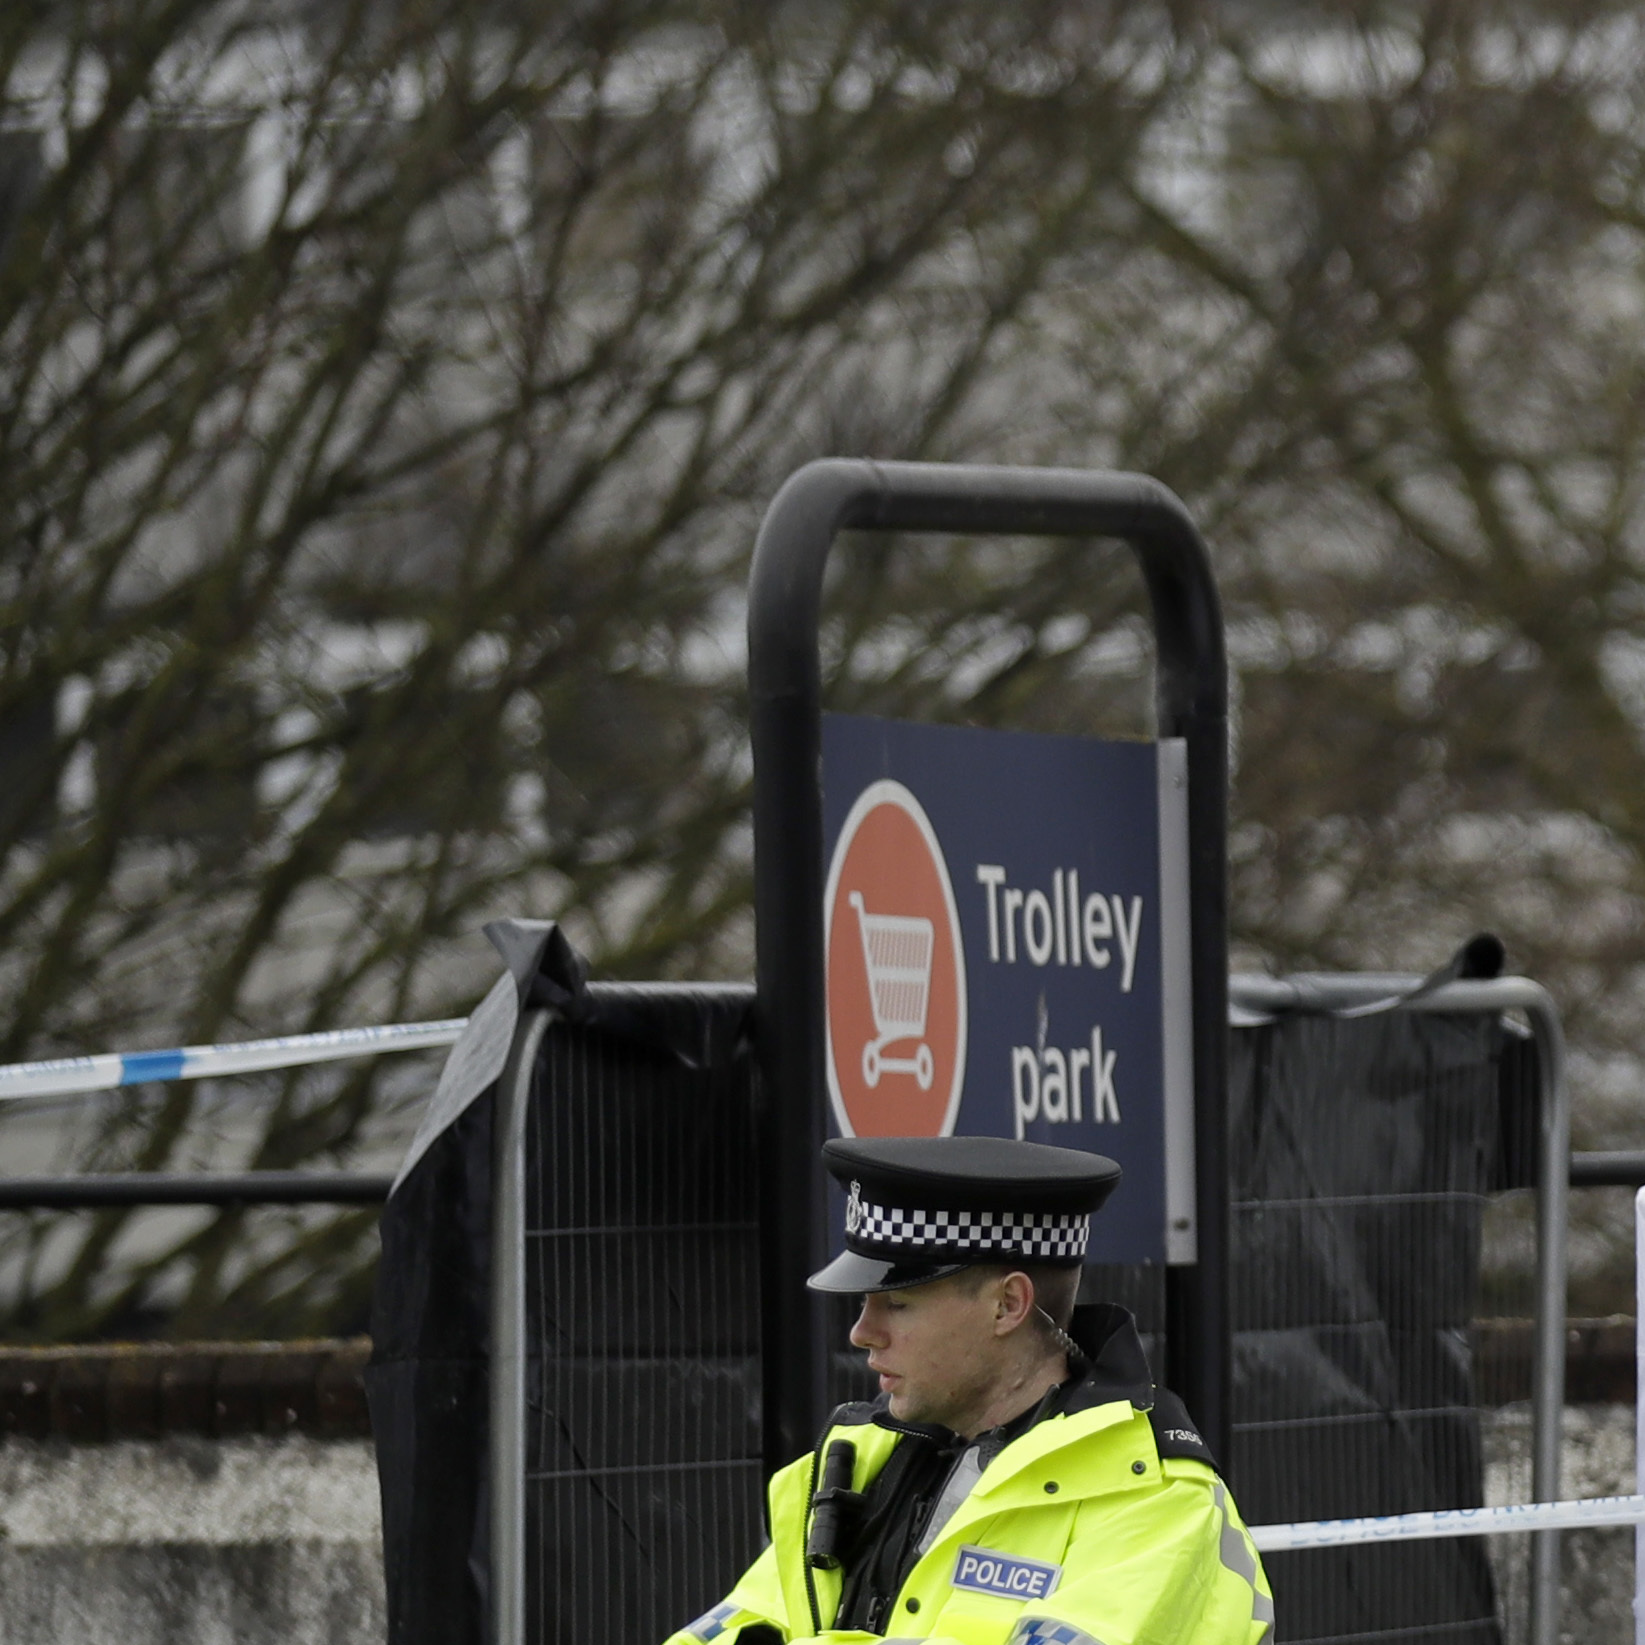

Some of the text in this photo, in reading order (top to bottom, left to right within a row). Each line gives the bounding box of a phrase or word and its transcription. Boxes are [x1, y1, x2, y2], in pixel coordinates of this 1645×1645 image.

[976, 863, 1143, 993] Trolley
[1011, 1025, 1121, 1141] park
[959, 1556, 1048, 1596] POLICE
